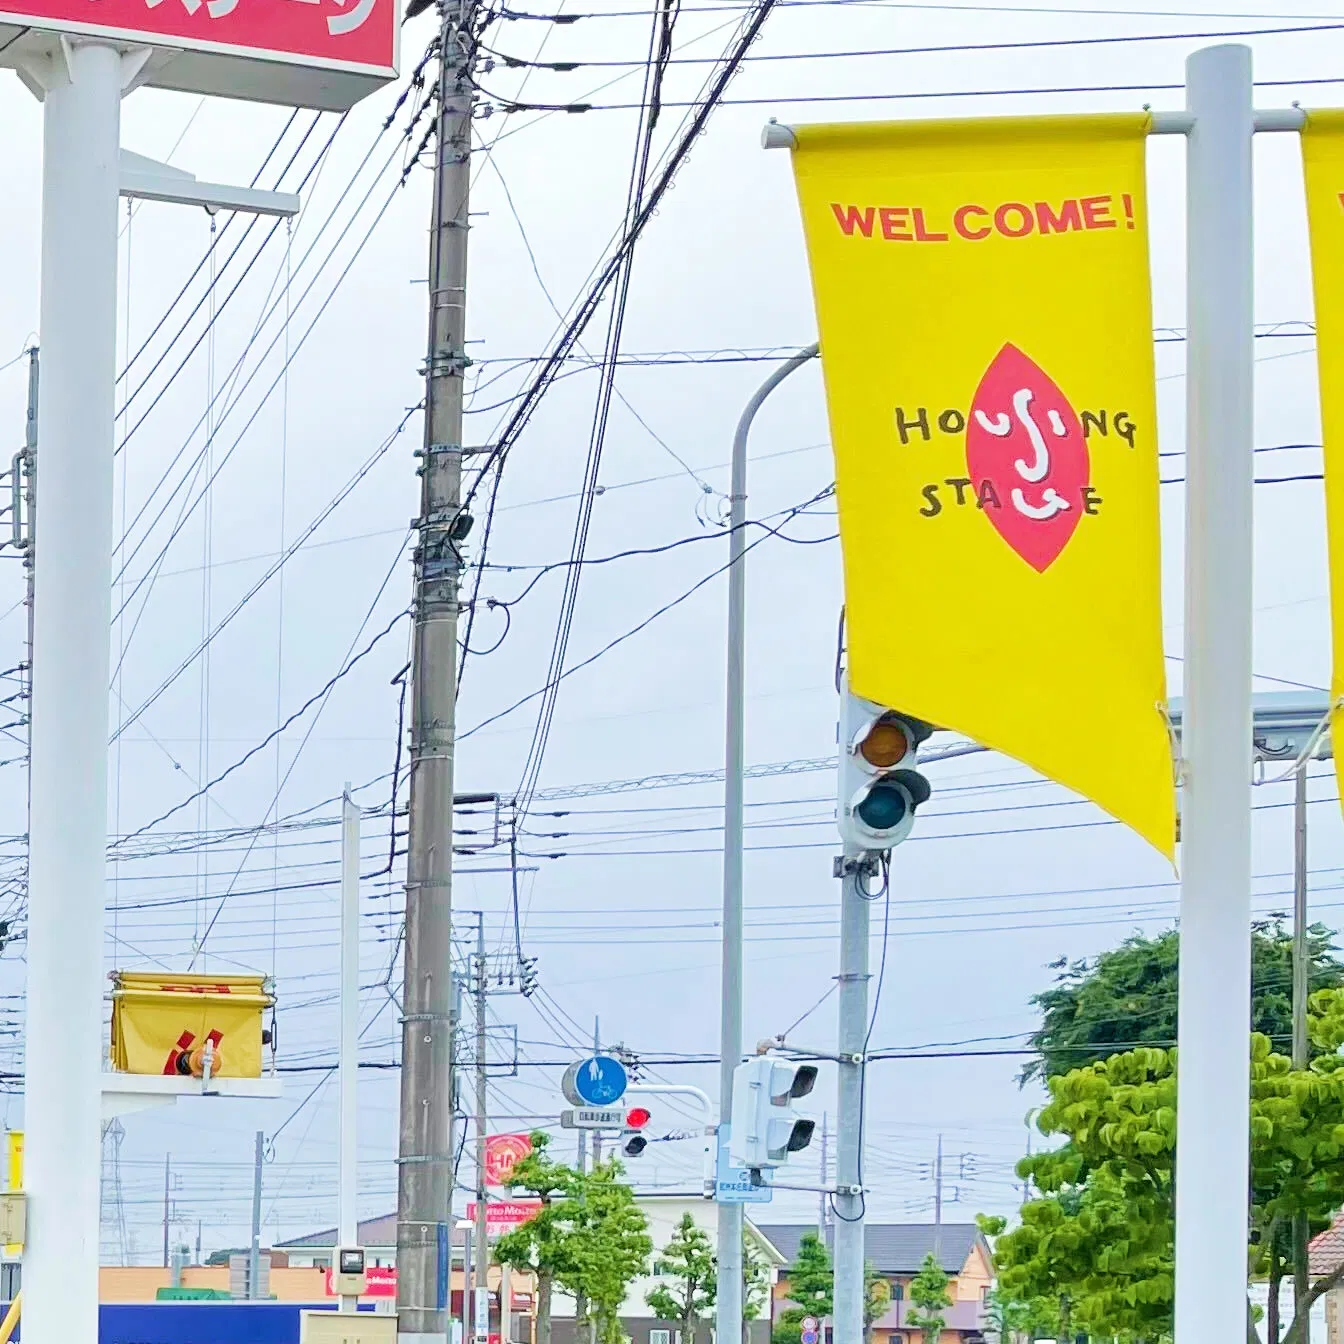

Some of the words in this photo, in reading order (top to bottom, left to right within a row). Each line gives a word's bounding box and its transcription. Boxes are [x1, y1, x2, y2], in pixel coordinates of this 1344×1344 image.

[830, 194, 1136, 242] WELCOME!
[896, 388, 1137, 483] HOUSING
[919, 478, 1103, 521] STAGE
